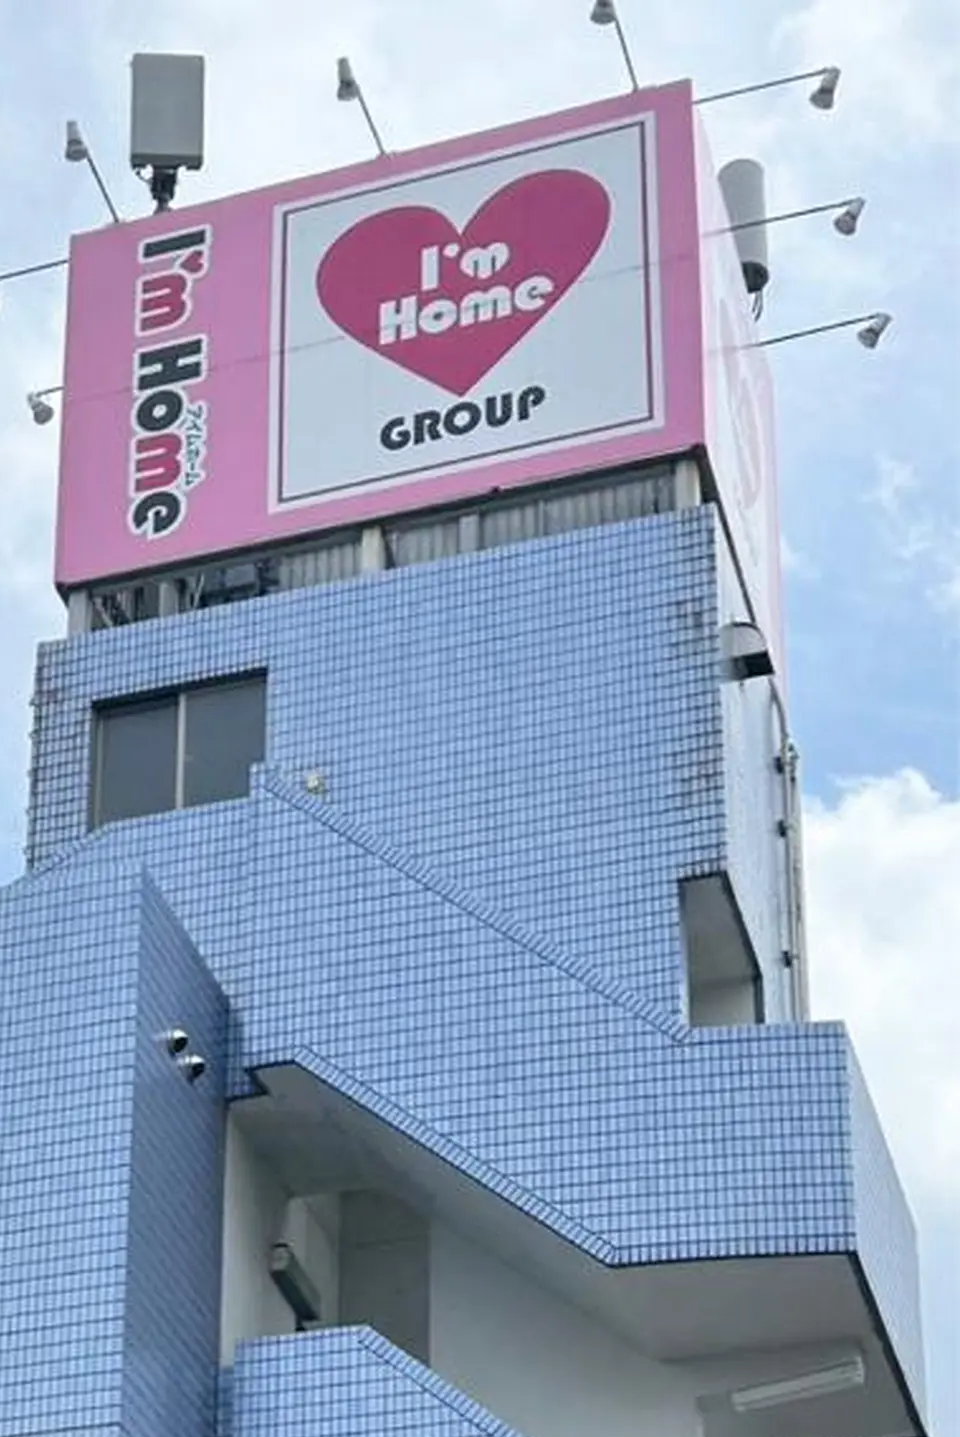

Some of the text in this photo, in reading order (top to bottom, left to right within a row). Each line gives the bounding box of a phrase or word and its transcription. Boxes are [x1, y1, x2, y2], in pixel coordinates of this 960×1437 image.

[420, 242, 510, 292] I'm
[380, 276, 554, 345] Home
[131, 335, 206, 537] Home
[380, 386, 546, 451] GROUP
